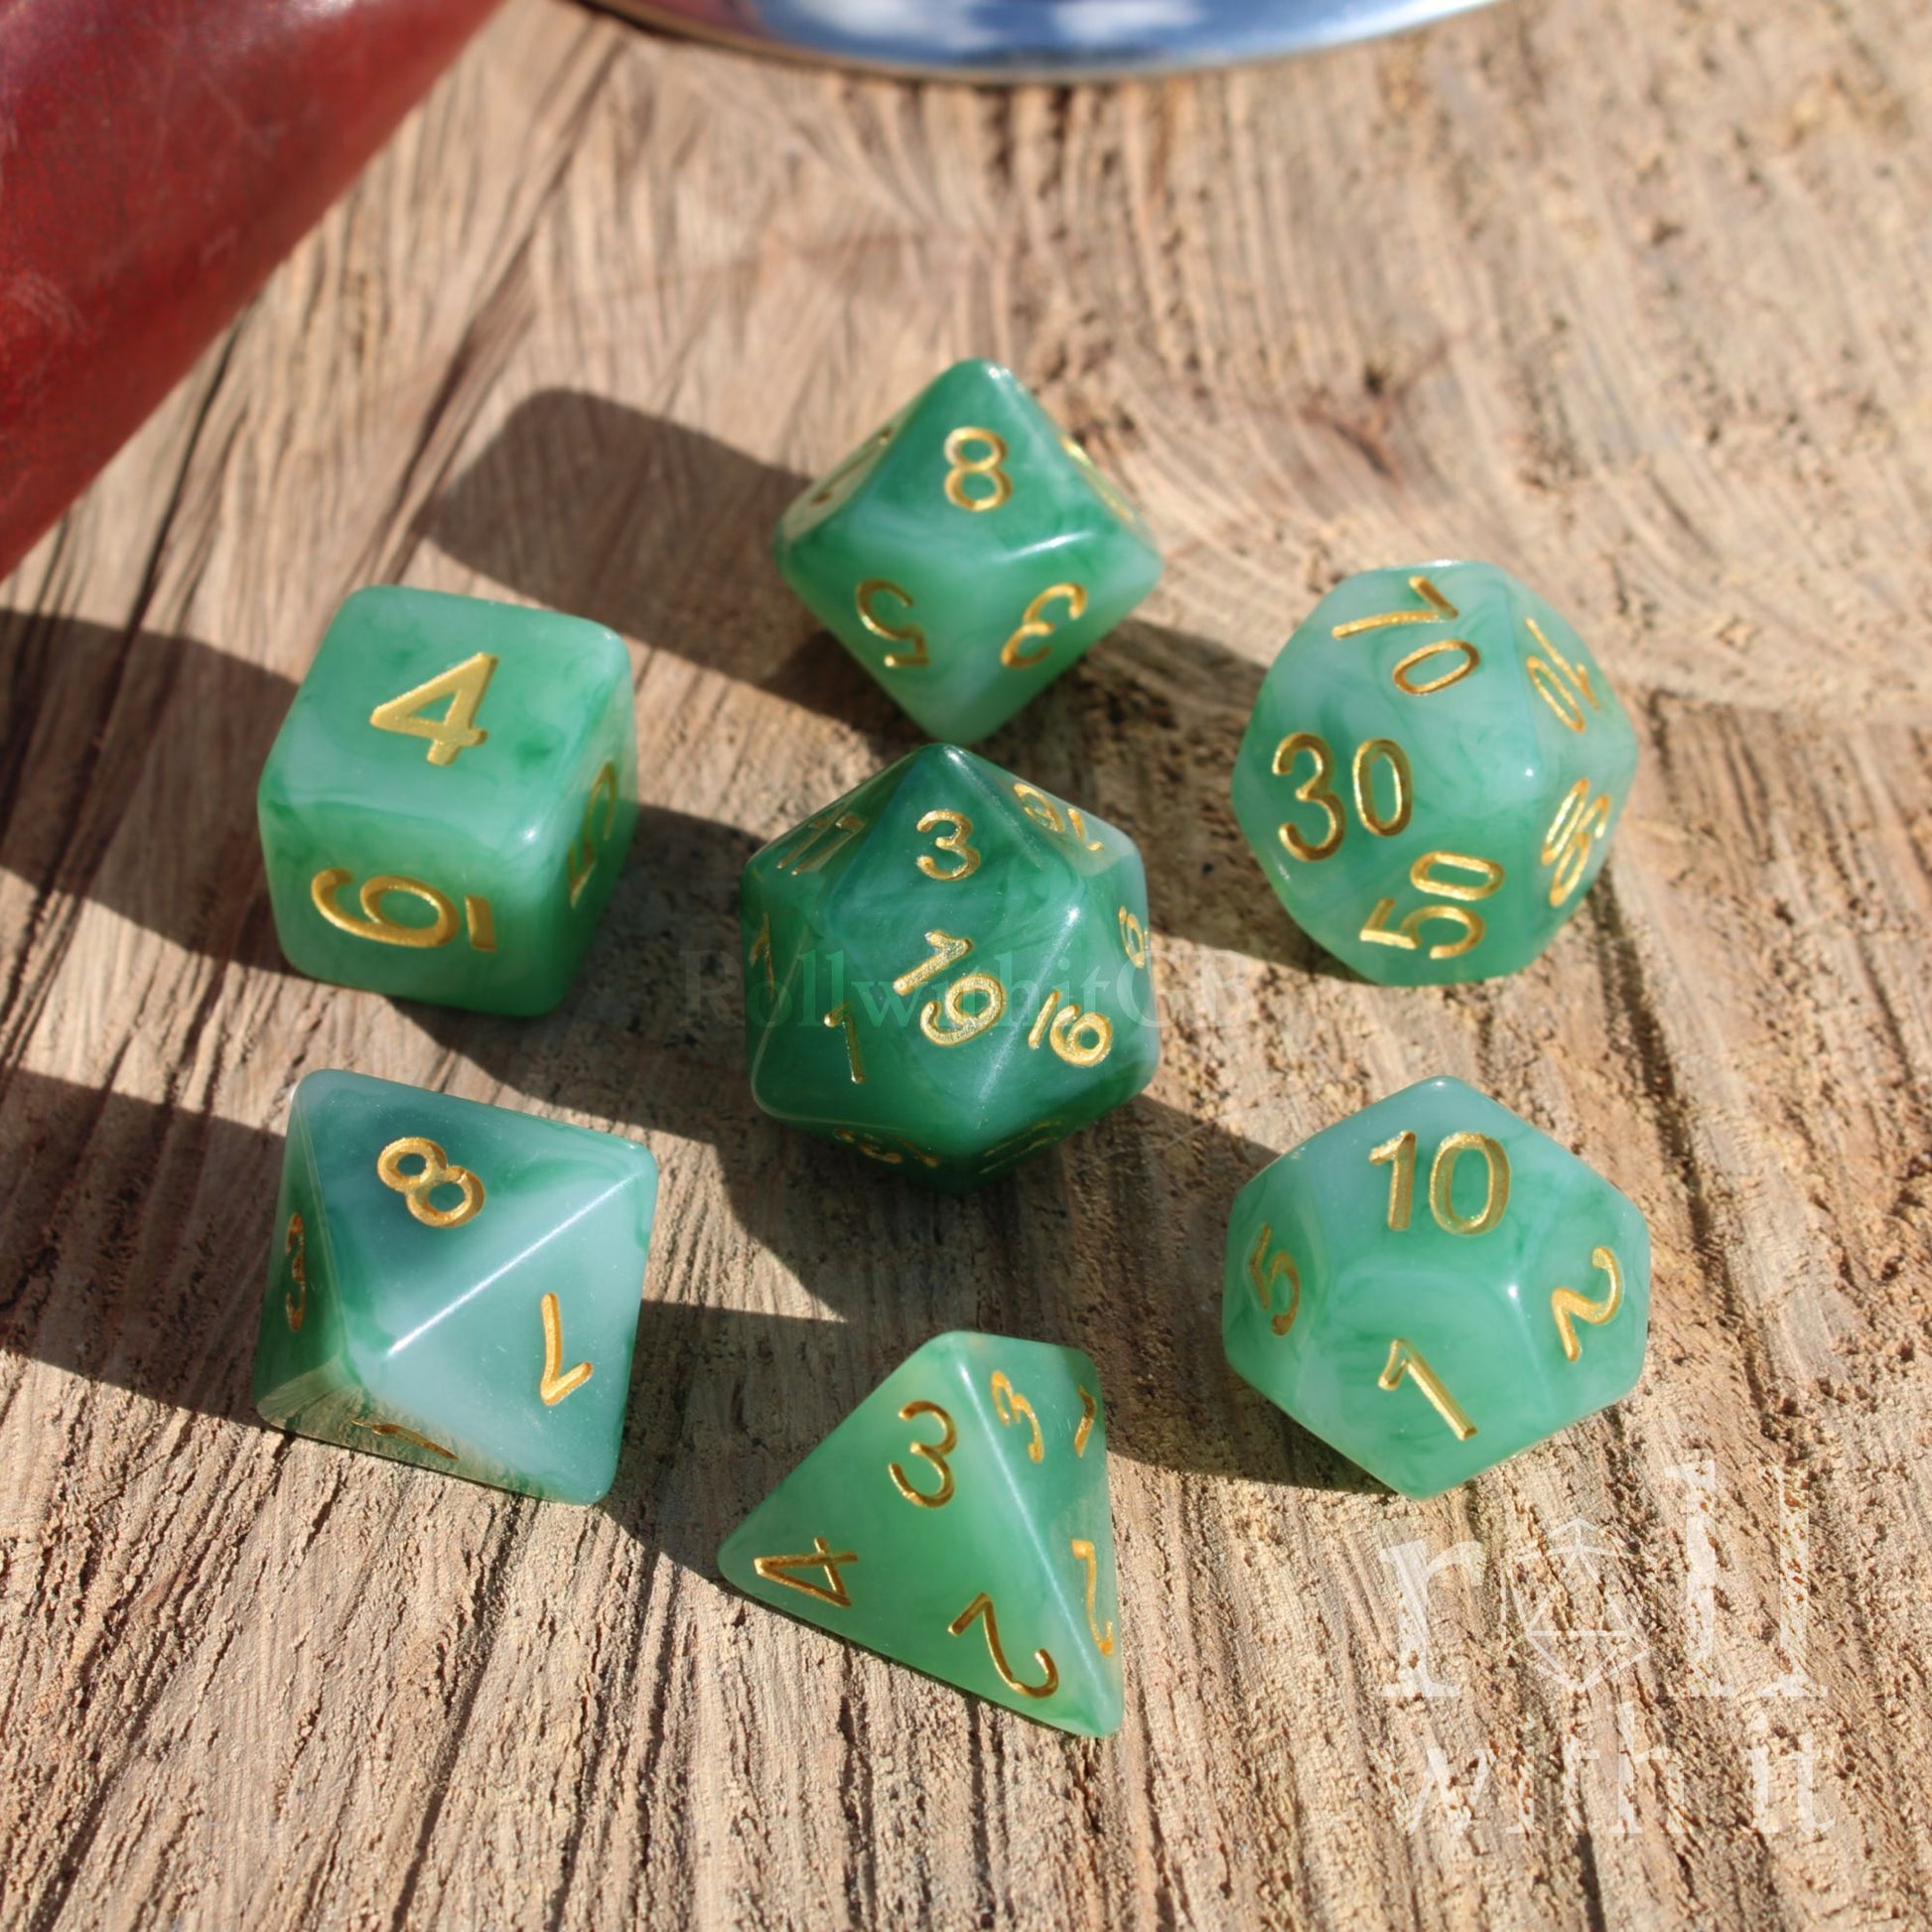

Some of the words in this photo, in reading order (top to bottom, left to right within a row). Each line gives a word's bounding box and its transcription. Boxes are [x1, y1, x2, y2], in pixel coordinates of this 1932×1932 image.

[943, 426, 1013, 510] 8
[855, 578, 929, 667] 5
[1001, 583, 1087, 668] 3
[369, 651, 499, 765] 4
[916, 809, 981, 881] 3
[1272, 732, 1414, 862] 30
[311, 868, 496, 952] 6
[1360, 851, 1504, 959] 50
[892, 928, 1006, 1045] 19
[376, 1136, 485, 1229] 8
[1369, 1130, 1511, 1236] 10
[1249, 1223, 1302, 1336] 5
[1552, 1246, 1623, 1362] 2
[889, 1400, 957, 1508] 3
[991, 1369, 1044, 1463] 3
[754, 1537, 859, 1607] 4
[947, 1592, 1059, 1699] 2
